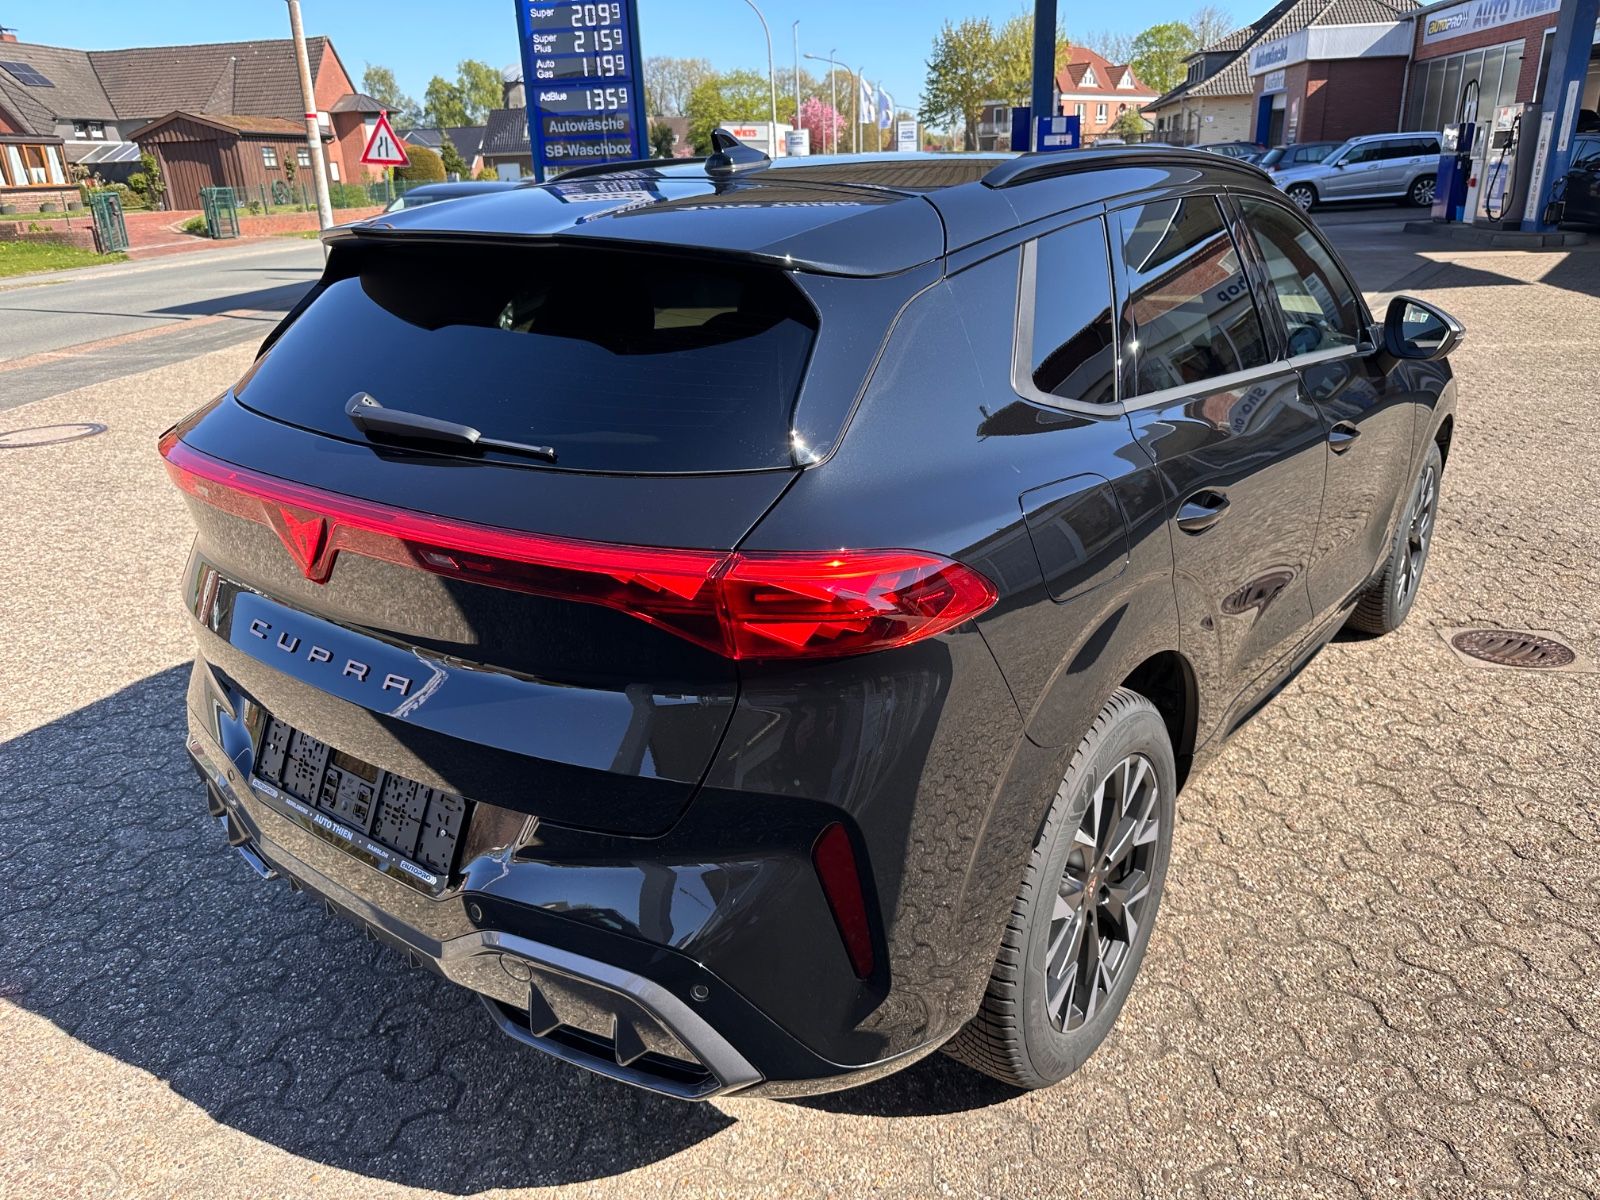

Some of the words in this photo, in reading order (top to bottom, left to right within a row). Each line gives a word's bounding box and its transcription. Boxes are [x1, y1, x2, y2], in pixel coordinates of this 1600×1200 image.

[530, 8, 554, 18] Super
[533, 34, 557, 44] Super
[534, 44, 552, 53] Plus
[536, 60, 555, 69] Auto
[537, 69, 554, 79] Gas
[540, 91, 567, 102] AdBlue
[549, 119, 625, 133] Autowäsche
[545, 143, 632, 158] SB-Waschbox
[249, 618, 413, 696] CUPRA
[313, 814, 332, 829] AUTO
[332, 823, 353, 841] THIEN
